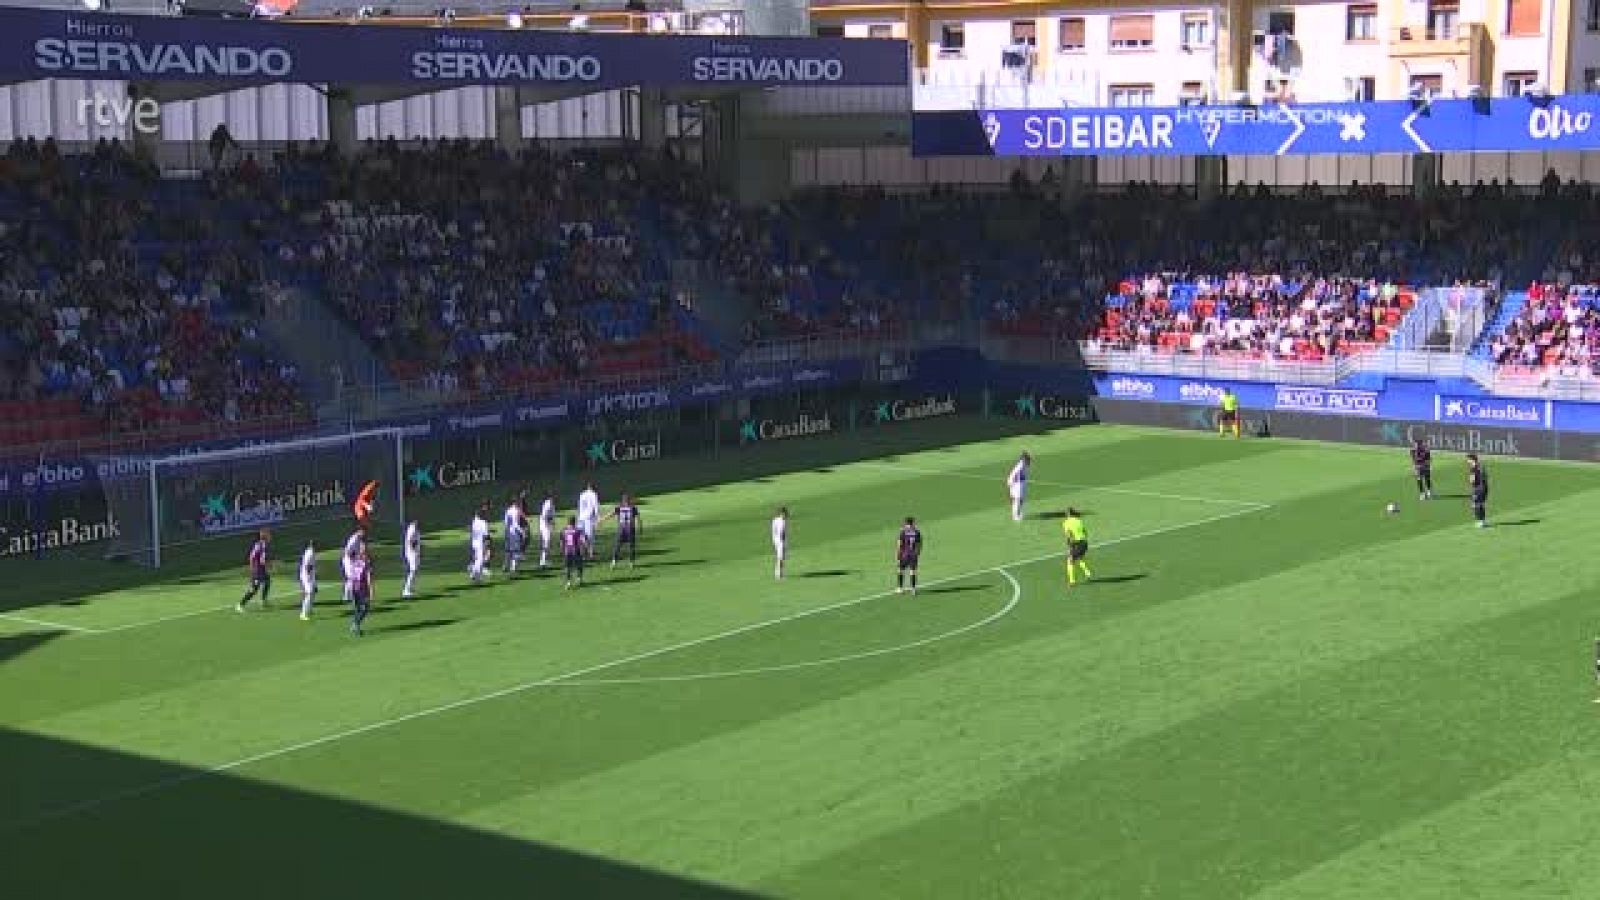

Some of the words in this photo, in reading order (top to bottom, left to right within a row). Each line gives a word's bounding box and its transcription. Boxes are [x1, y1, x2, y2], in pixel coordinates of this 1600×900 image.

[66, 19, 133, 38] Hierros
[759, 407, 831, 439] CaixaBank
[1467, 401, 1540, 421] CaixaBank
[1407, 425, 1519, 455] CaixaBank
[234, 479, 347, 513] CaixaBank
